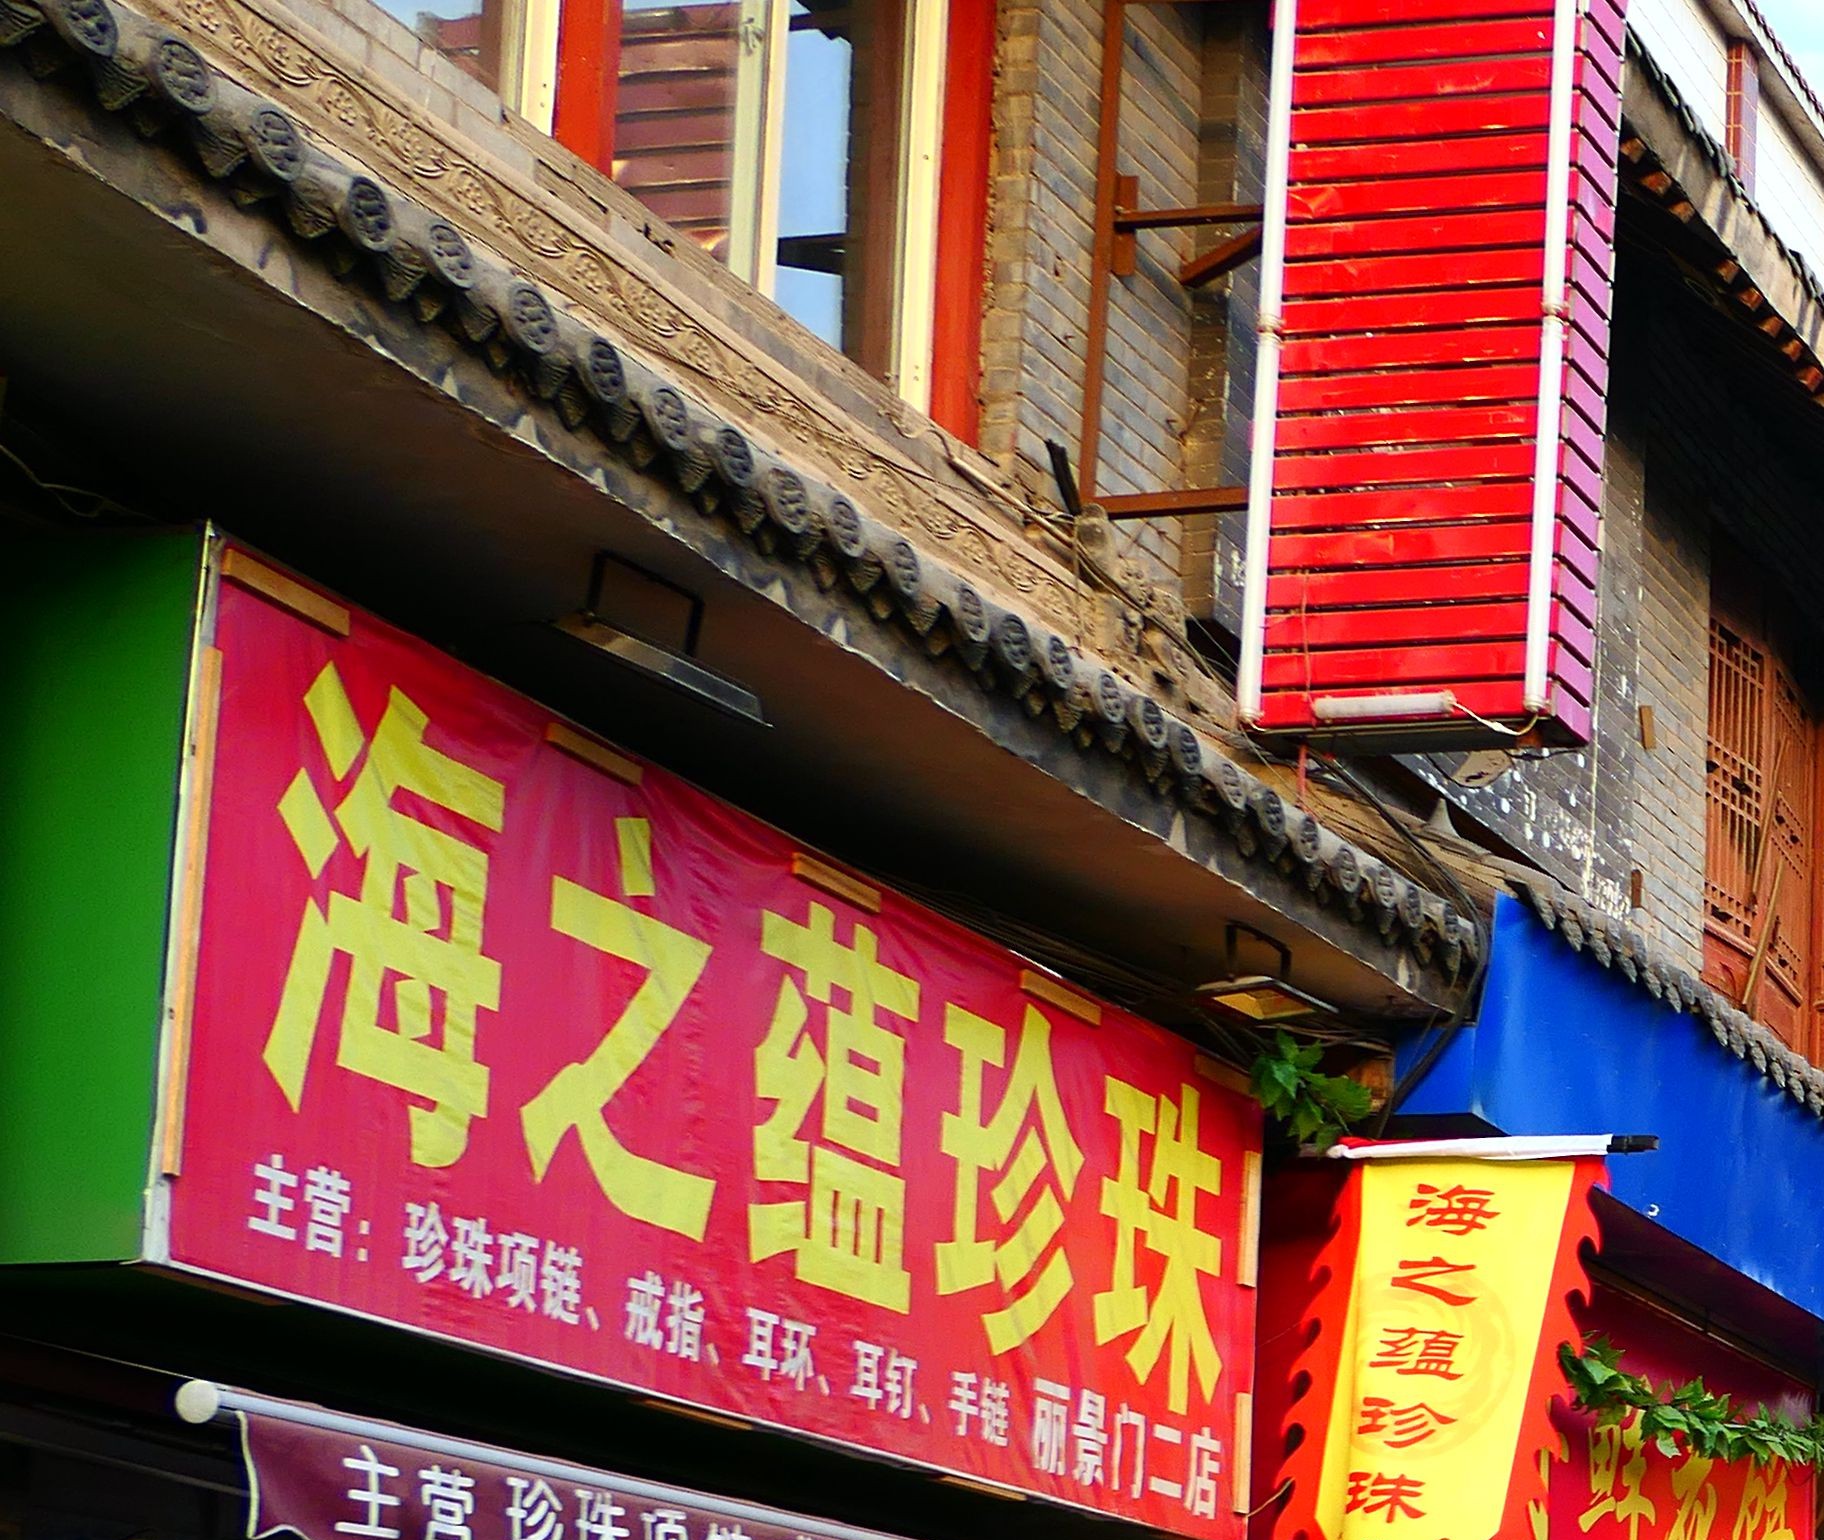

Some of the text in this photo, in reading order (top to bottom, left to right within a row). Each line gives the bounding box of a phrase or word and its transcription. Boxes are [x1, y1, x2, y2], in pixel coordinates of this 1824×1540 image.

[262, 660, 1224, 1415] 海之蕴珍珠
[1032, 1377, 1223, 1521] 丽景门二店
[1345, 1183, 1501, 1523] 海之蕴珍珠
